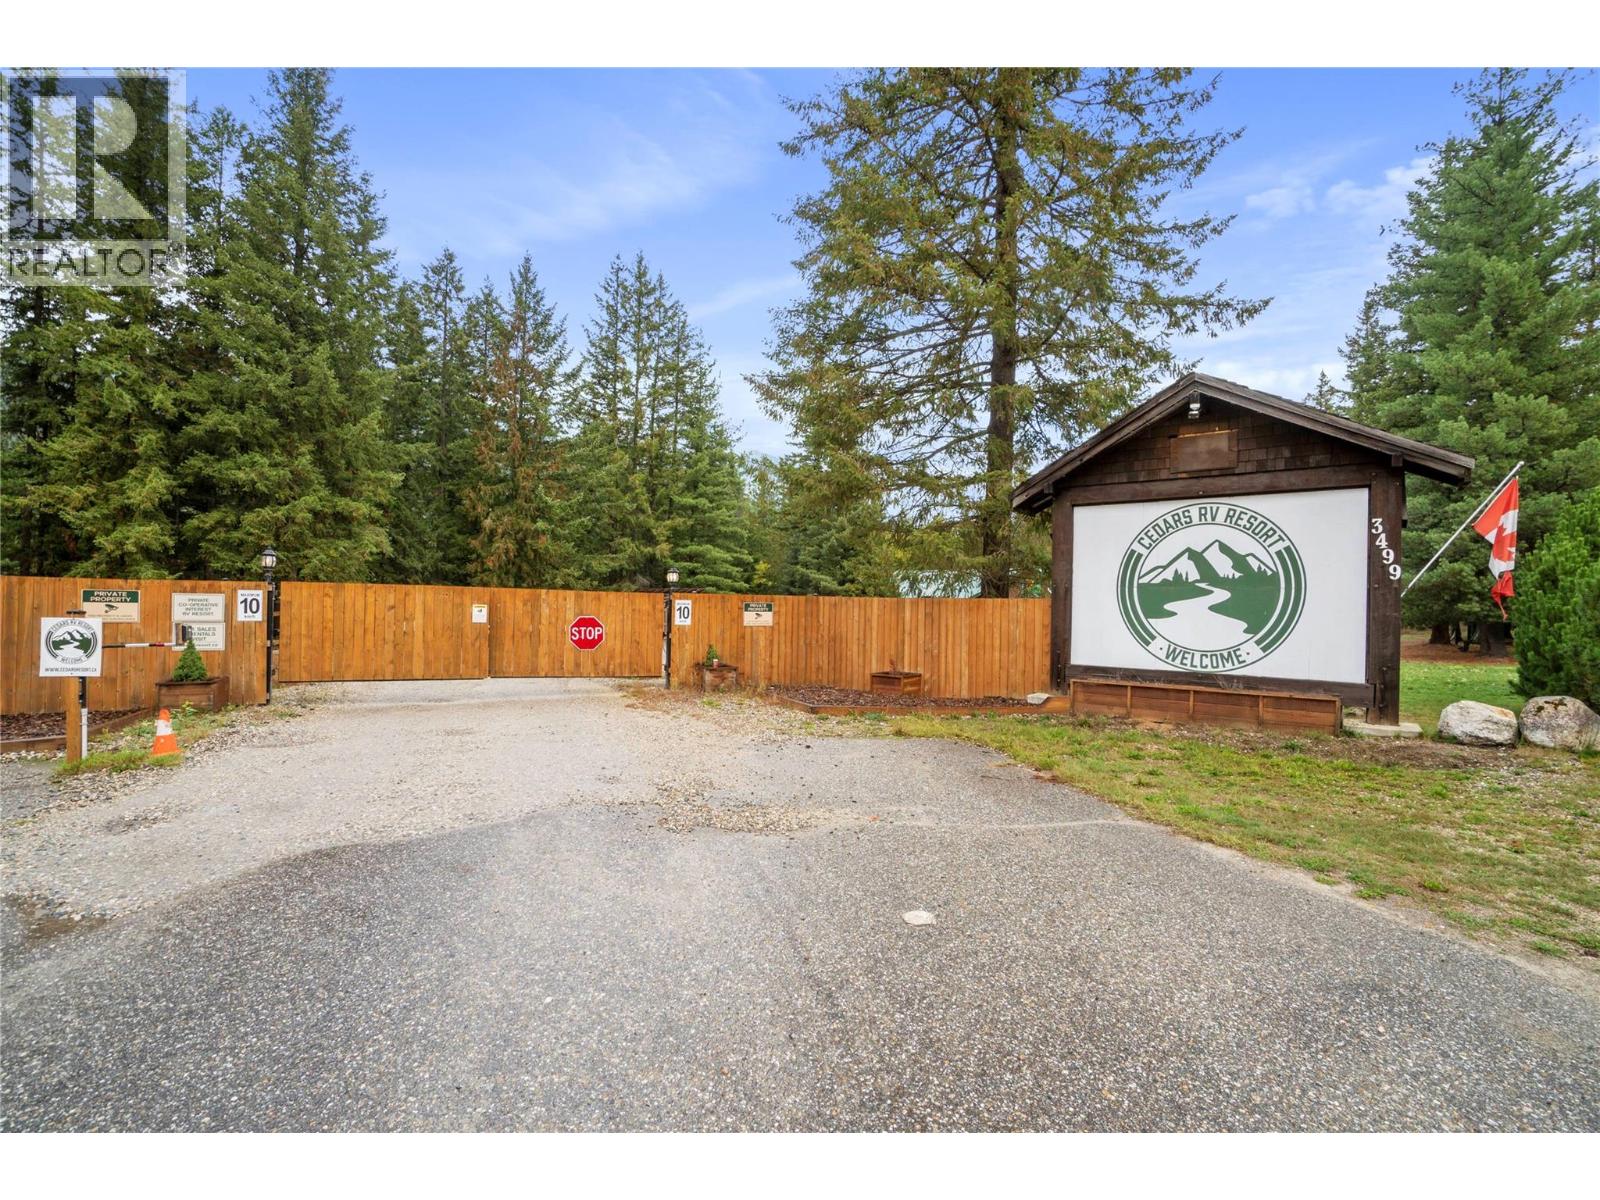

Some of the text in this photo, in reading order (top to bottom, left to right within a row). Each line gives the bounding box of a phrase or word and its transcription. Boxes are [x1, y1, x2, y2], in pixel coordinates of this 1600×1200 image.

[1137, 505, 1287, 551] CEDARS RV RESORT
[1371, 518, 1402, 581] 3499
[240, 597, 260, 614] 10
[676, 606, 690, 619] 10
[570, 626, 603, 641] STOP
[1163, 647, 1245, 669] WELCOME
